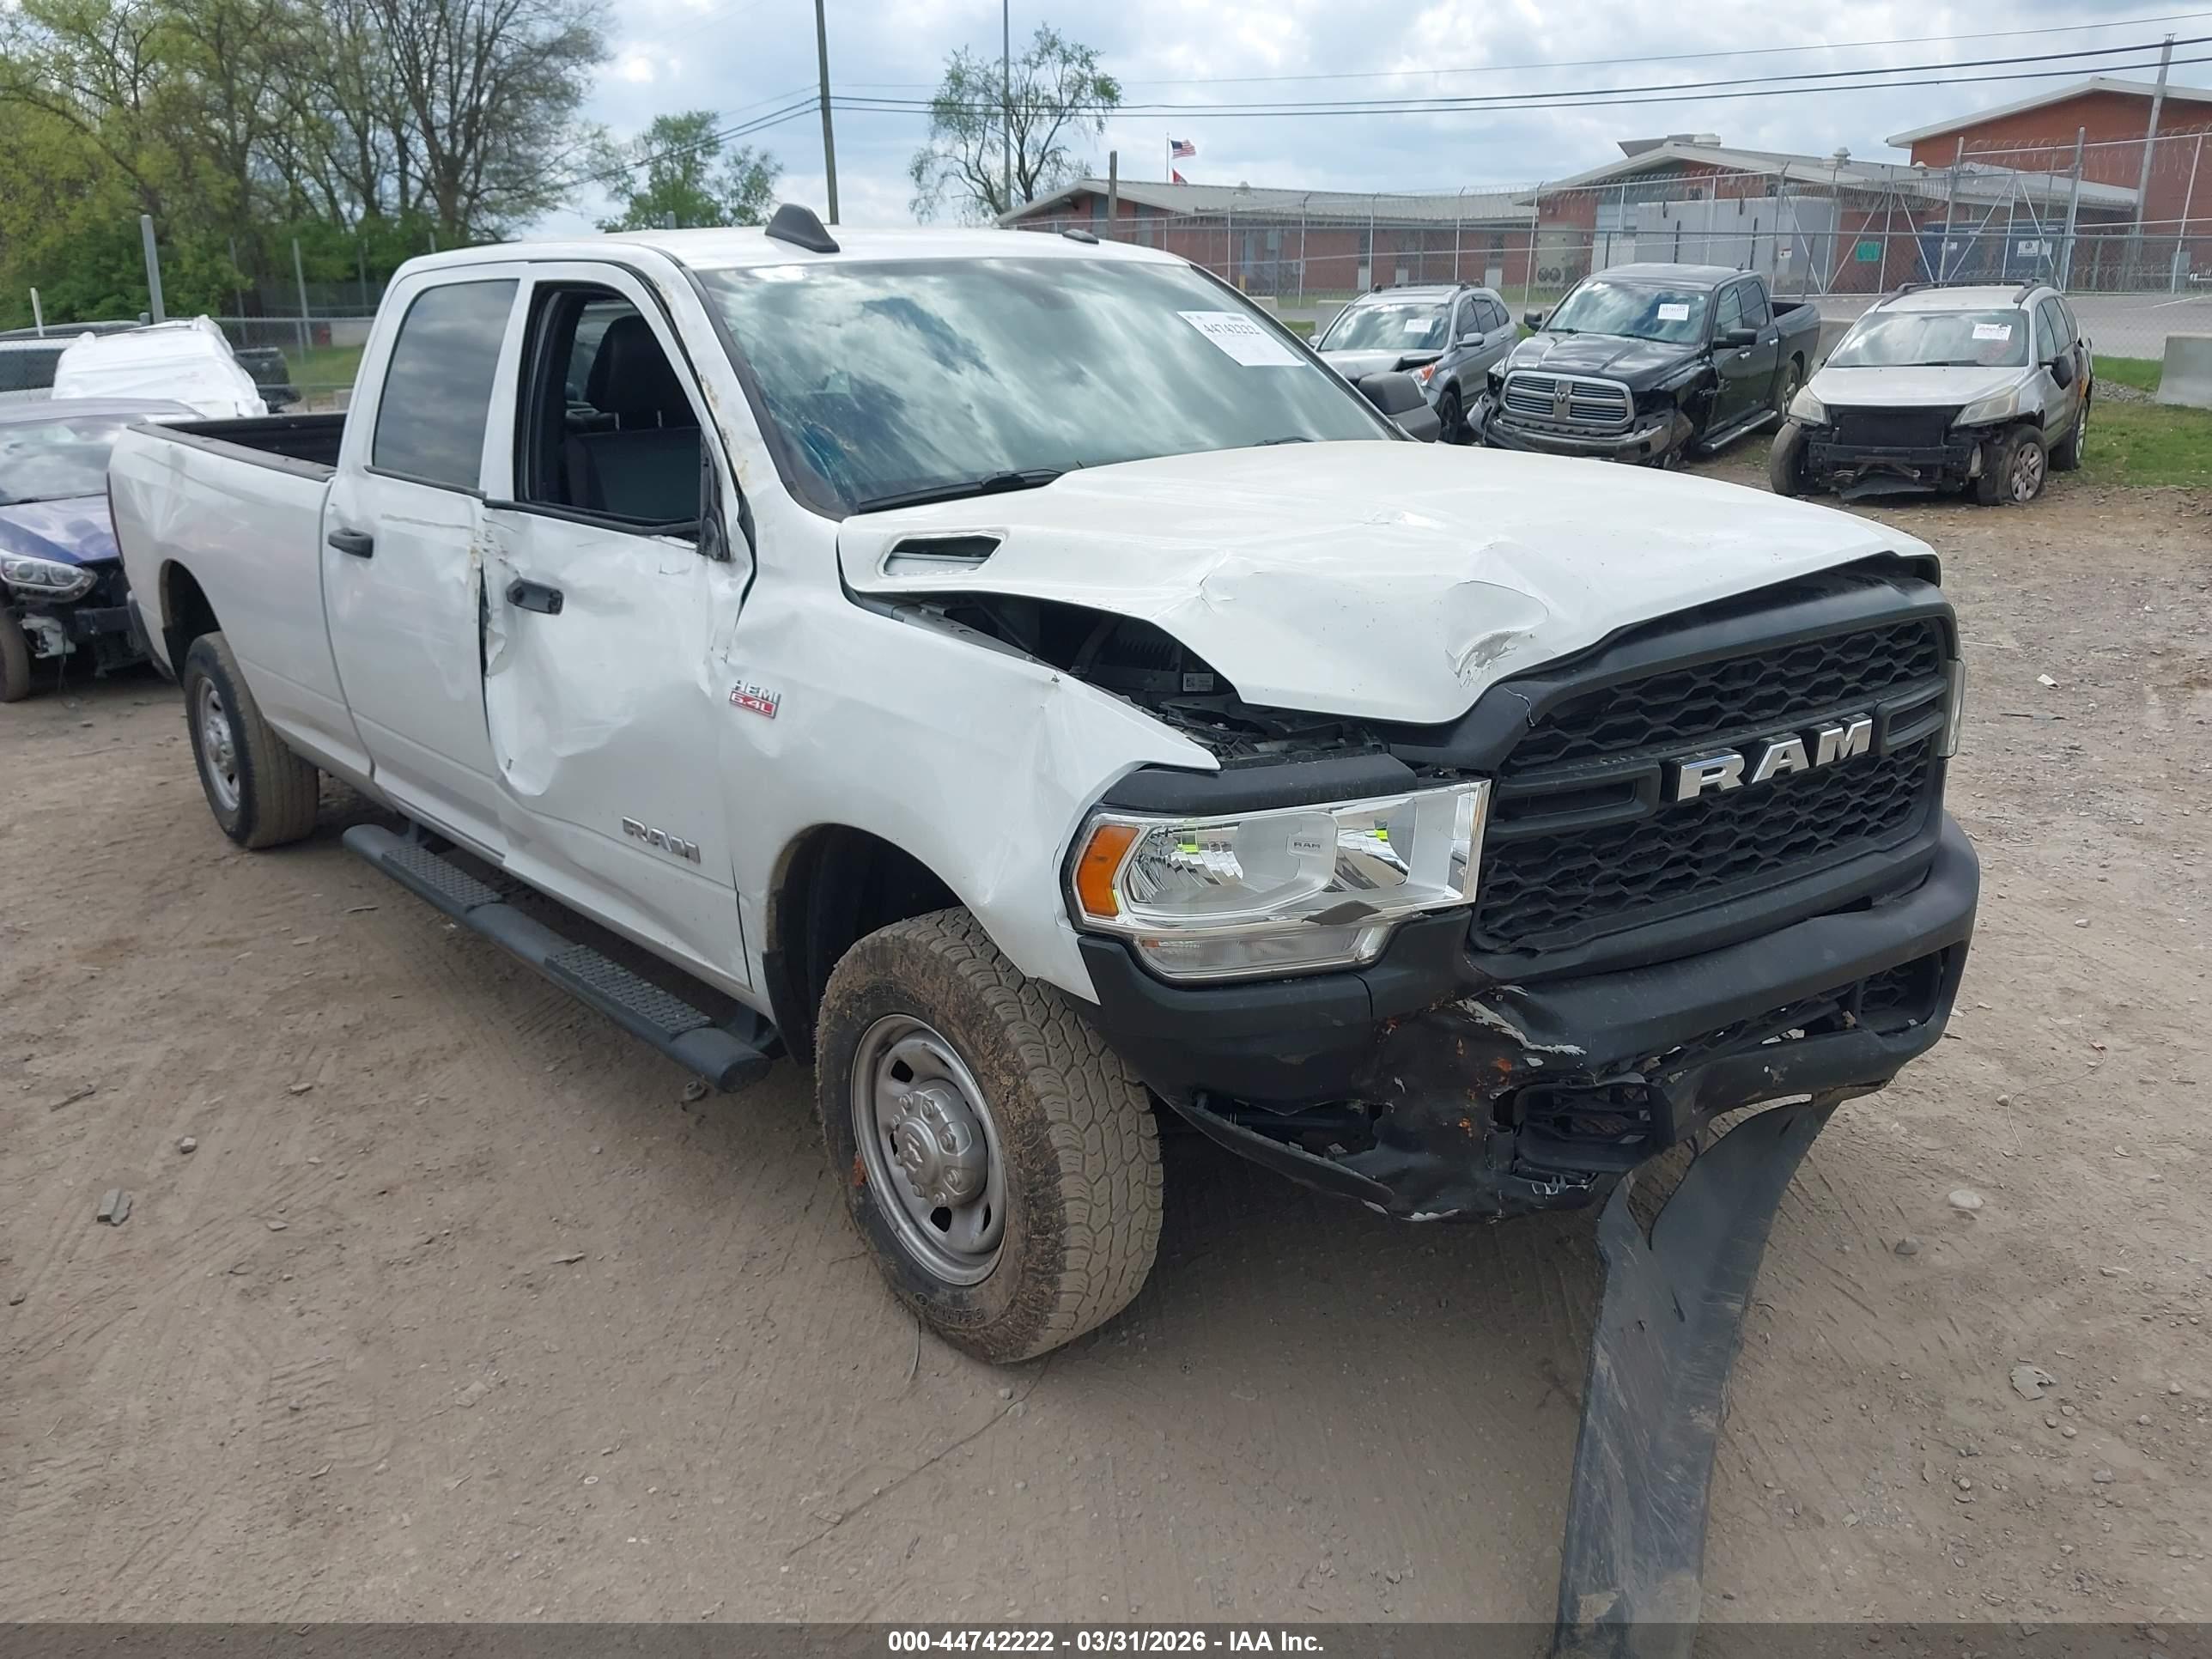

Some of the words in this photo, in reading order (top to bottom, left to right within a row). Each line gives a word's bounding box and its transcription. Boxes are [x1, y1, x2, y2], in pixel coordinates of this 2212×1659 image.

[1203, 323, 1261, 336] 44742222
[730, 692, 774, 715] 6.4L
[733, 679, 781, 704] HEMI
[1676, 714, 1873, 802] RAM
[623, 816, 701, 866] RAM
